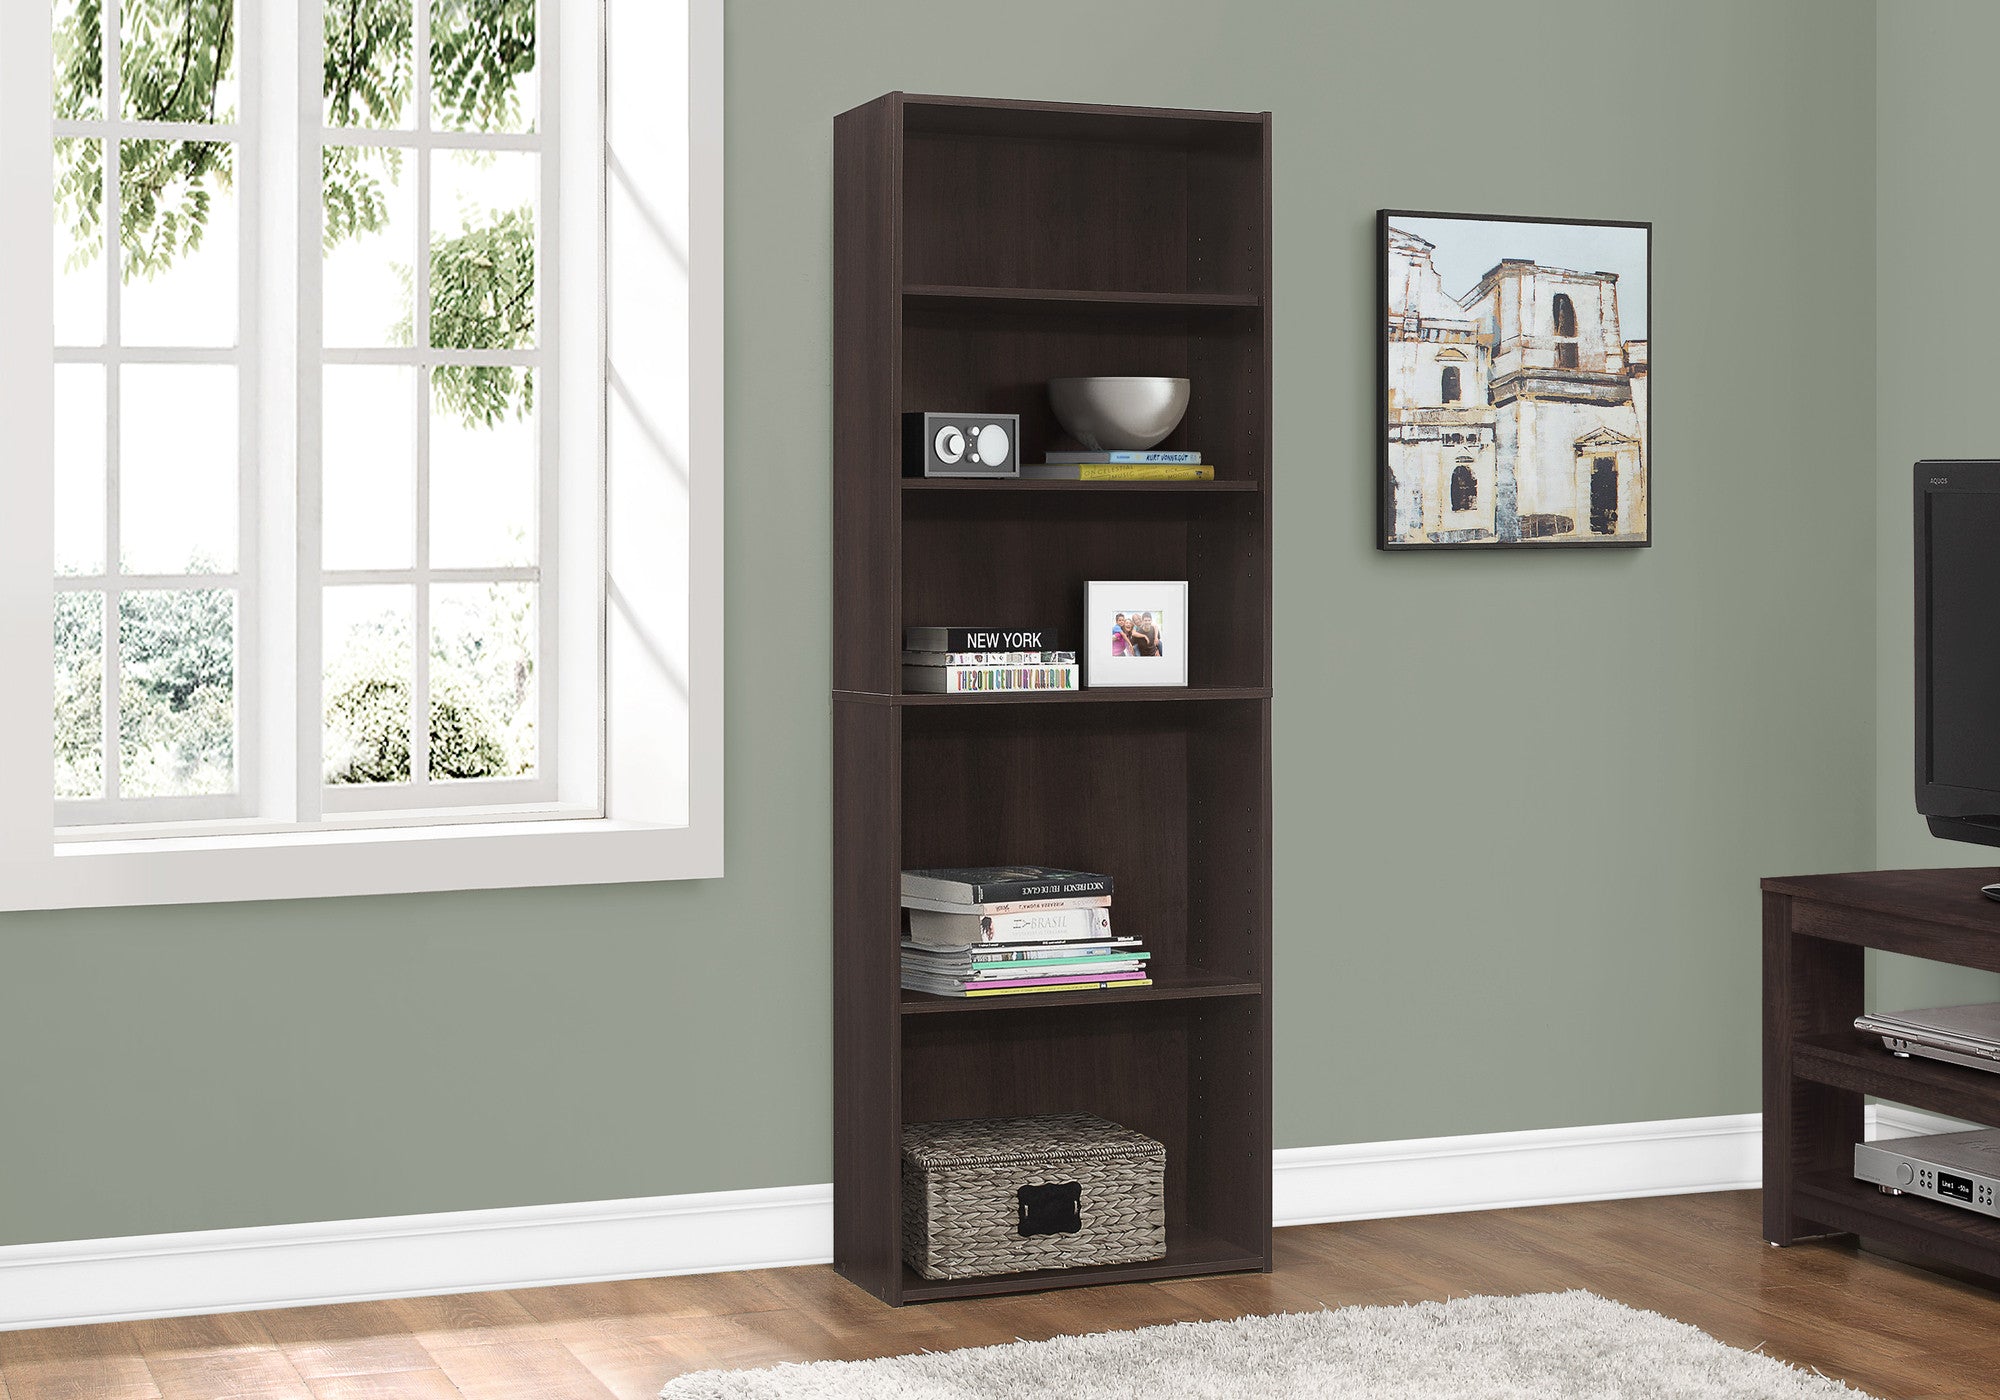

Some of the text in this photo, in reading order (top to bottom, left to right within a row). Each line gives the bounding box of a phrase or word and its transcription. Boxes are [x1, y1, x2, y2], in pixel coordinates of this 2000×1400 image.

[967, 632, 1042, 649] NEW YORK
[995, 669, 1033, 690] CENTURY
